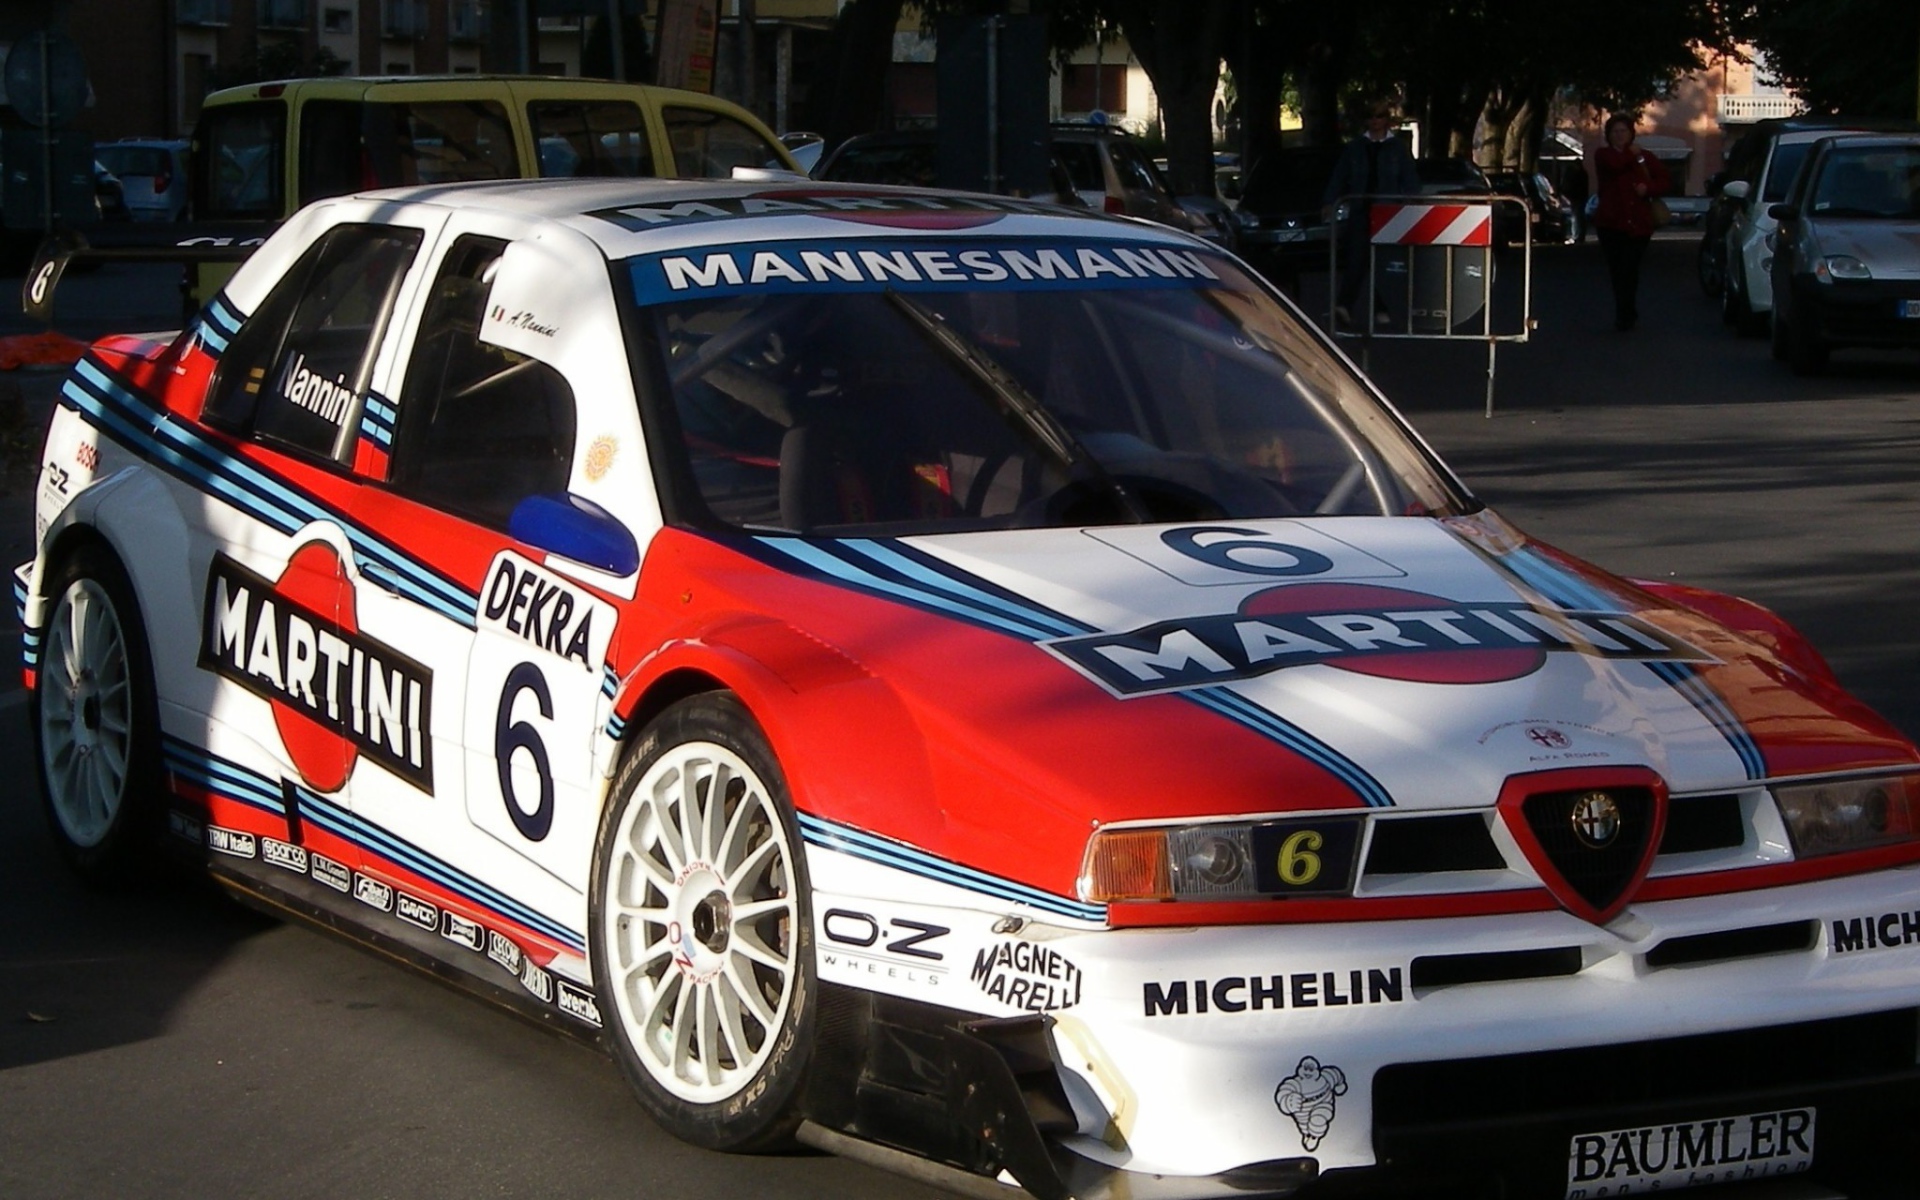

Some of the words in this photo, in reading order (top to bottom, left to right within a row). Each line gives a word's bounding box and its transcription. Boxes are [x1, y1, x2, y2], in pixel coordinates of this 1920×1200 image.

[30, 260, 56, 304] 6
[661, 246, 1219, 291] MANNESMANN
[1158, 526, 1334, 576] 6
[484, 558, 595, 672] DEKRA
[1094, 607, 1674, 682] MARTINI
[212, 576, 422, 769] MARTINI
[494, 660, 555, 842] 6
[264, 839, 307, 865] sparco
[1276, 829, 1324, 886] 6
[823, 954, 940, 986] WHEELS
[1143, 967, 1403, 1017] MICHELIN
[1572, 1109, 1812, 1183] BÄUMLER
